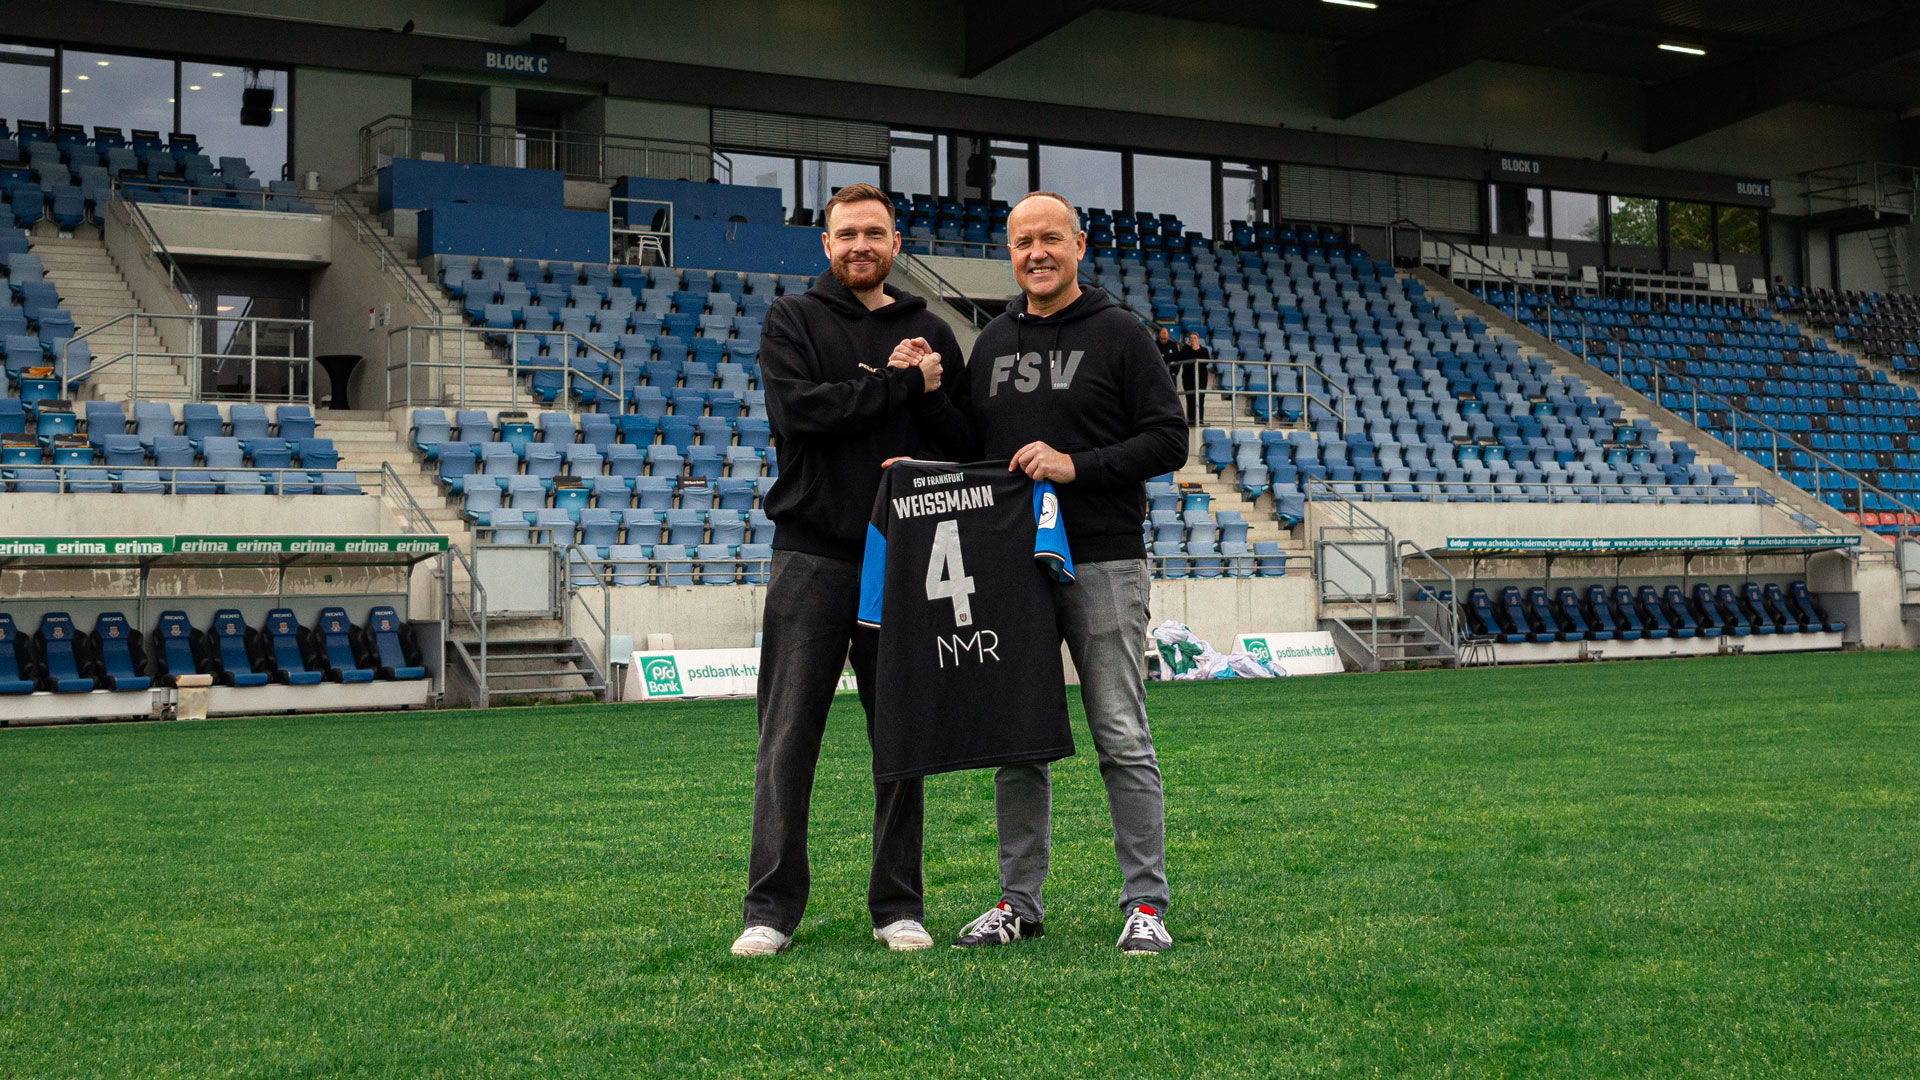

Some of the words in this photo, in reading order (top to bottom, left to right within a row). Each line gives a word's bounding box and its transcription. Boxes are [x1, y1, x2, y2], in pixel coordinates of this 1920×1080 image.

[486, 52, 535, 72] BLOCK
[538, 57, 548, 73] C
[1501, 158, 1531, 173] BLOCK
[1532, 161, 1540, 174] D
[1736, 182, 1763, 196] BLOCK
[1764, 185, 1770, 197] E
[989, 350, 1086, 398] FSV
[913, 478, 926, 488] FSV
[927, 472, 964, 485] FRANKFURT
[892, 485, 995, 520] WEISSMANN
[0, 541, 45, 554] erima
[56, 540, 106, 554] erima
[114, 540, 164, 553] erima
[181, 539, 228, 552] erima
[236, 539, 282, 552] erima
[290, 539, 335, 552] erima
[345, 540, 389, 552] erima
[396, 540, 440, 552] erima
[925, 519, 976, 628] 4
[937, 629, 1000, 668] NMR
[1276, 644, 1336, 661] psdbank-ht.de
[652, 664, 676, 680] psd
[649, 680, 681, 693] Bank
